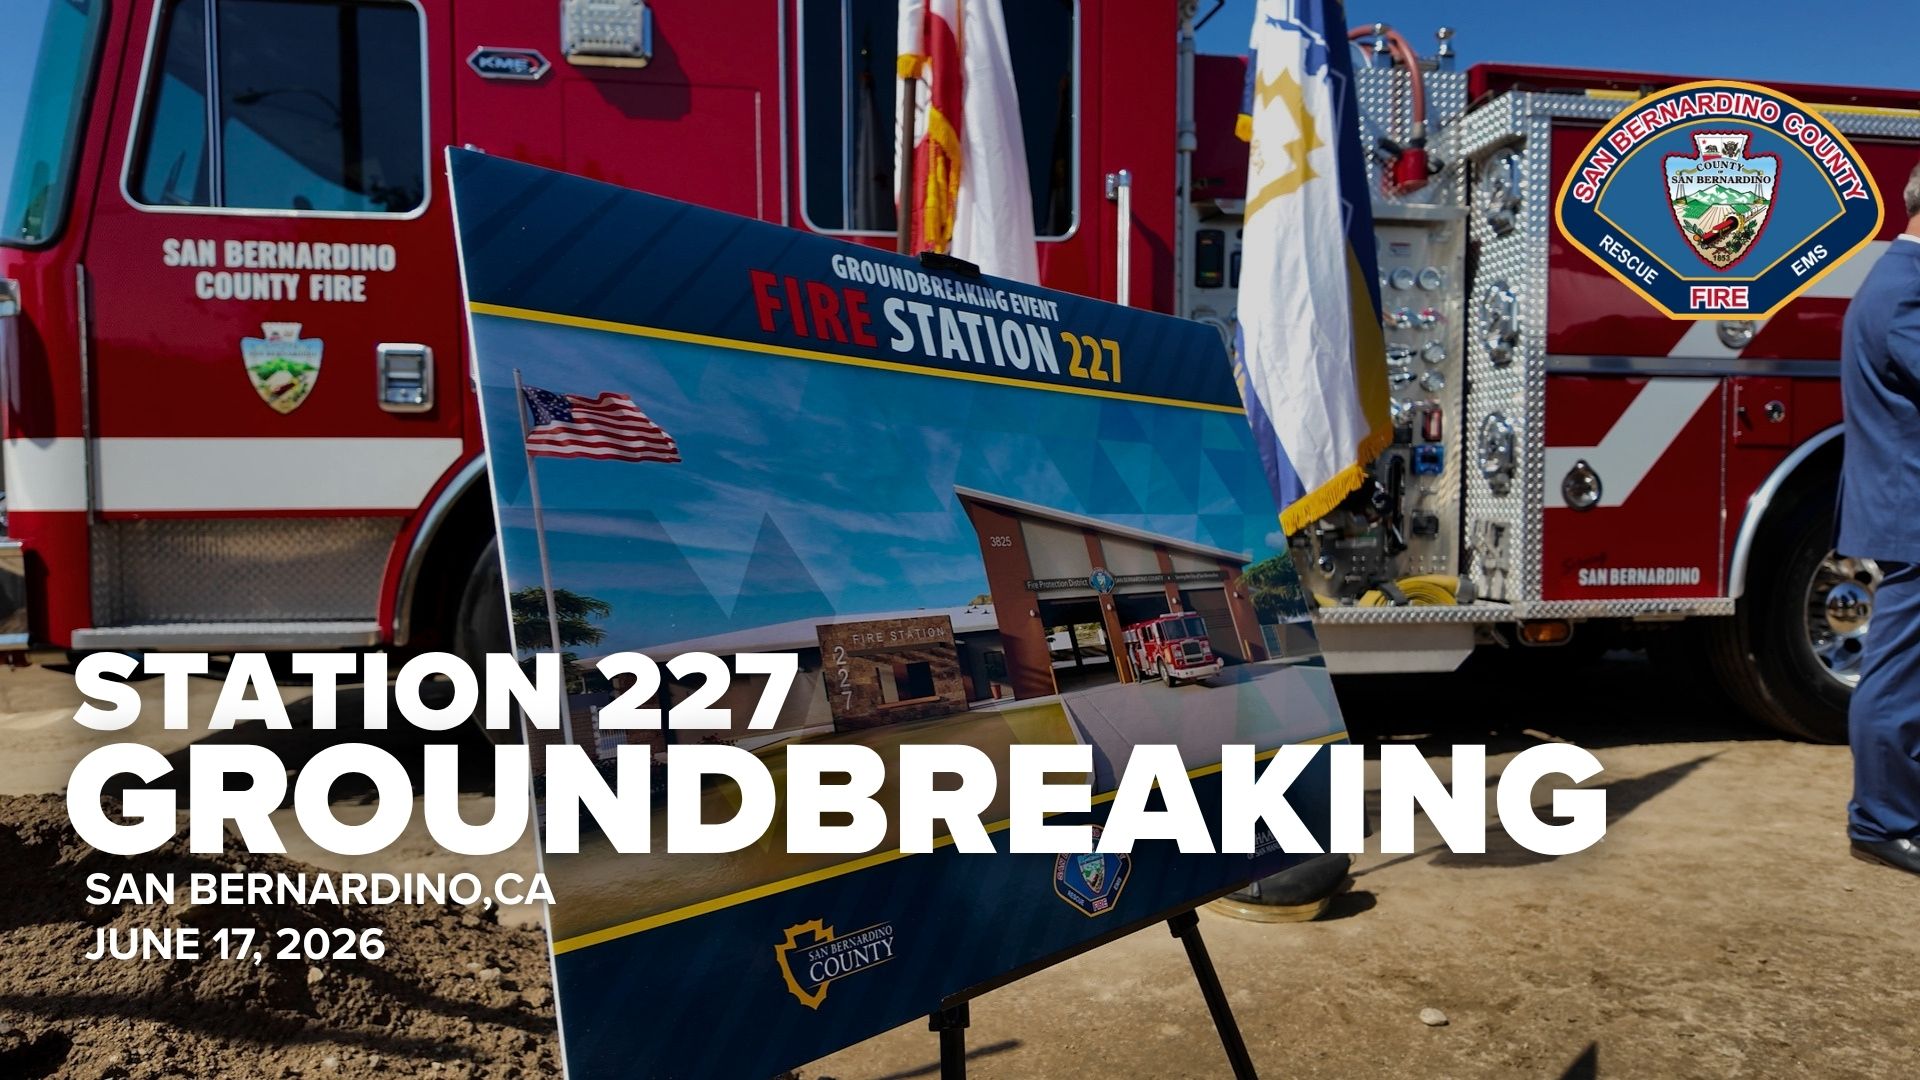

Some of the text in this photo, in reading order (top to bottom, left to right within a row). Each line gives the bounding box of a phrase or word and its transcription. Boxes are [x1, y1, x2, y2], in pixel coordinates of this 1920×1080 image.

[479, 57, 528, 72] KME
[163, 238, 396, 272] SAN BERNARDINO
[195, 271, 367, 302] COUNTY FIRE
[831, 254, 1059, 322] GROUNDBREAKING EVENT
[750, 268, 1123, 384] FIRE STATION 227
[990, 536, 1012, 547] 3825
[1027, 578, 1089, 589] Fire Protection District
[1578, 567, 1701, 586] SAN BERNARDINO
[852, 627, 945, 644] FIRE STATION
[833, 646, 853, 710] 227
[808, 925, 893, 962] SAN BERNARDINO
[809, 937, 894, 982] COUNTY
